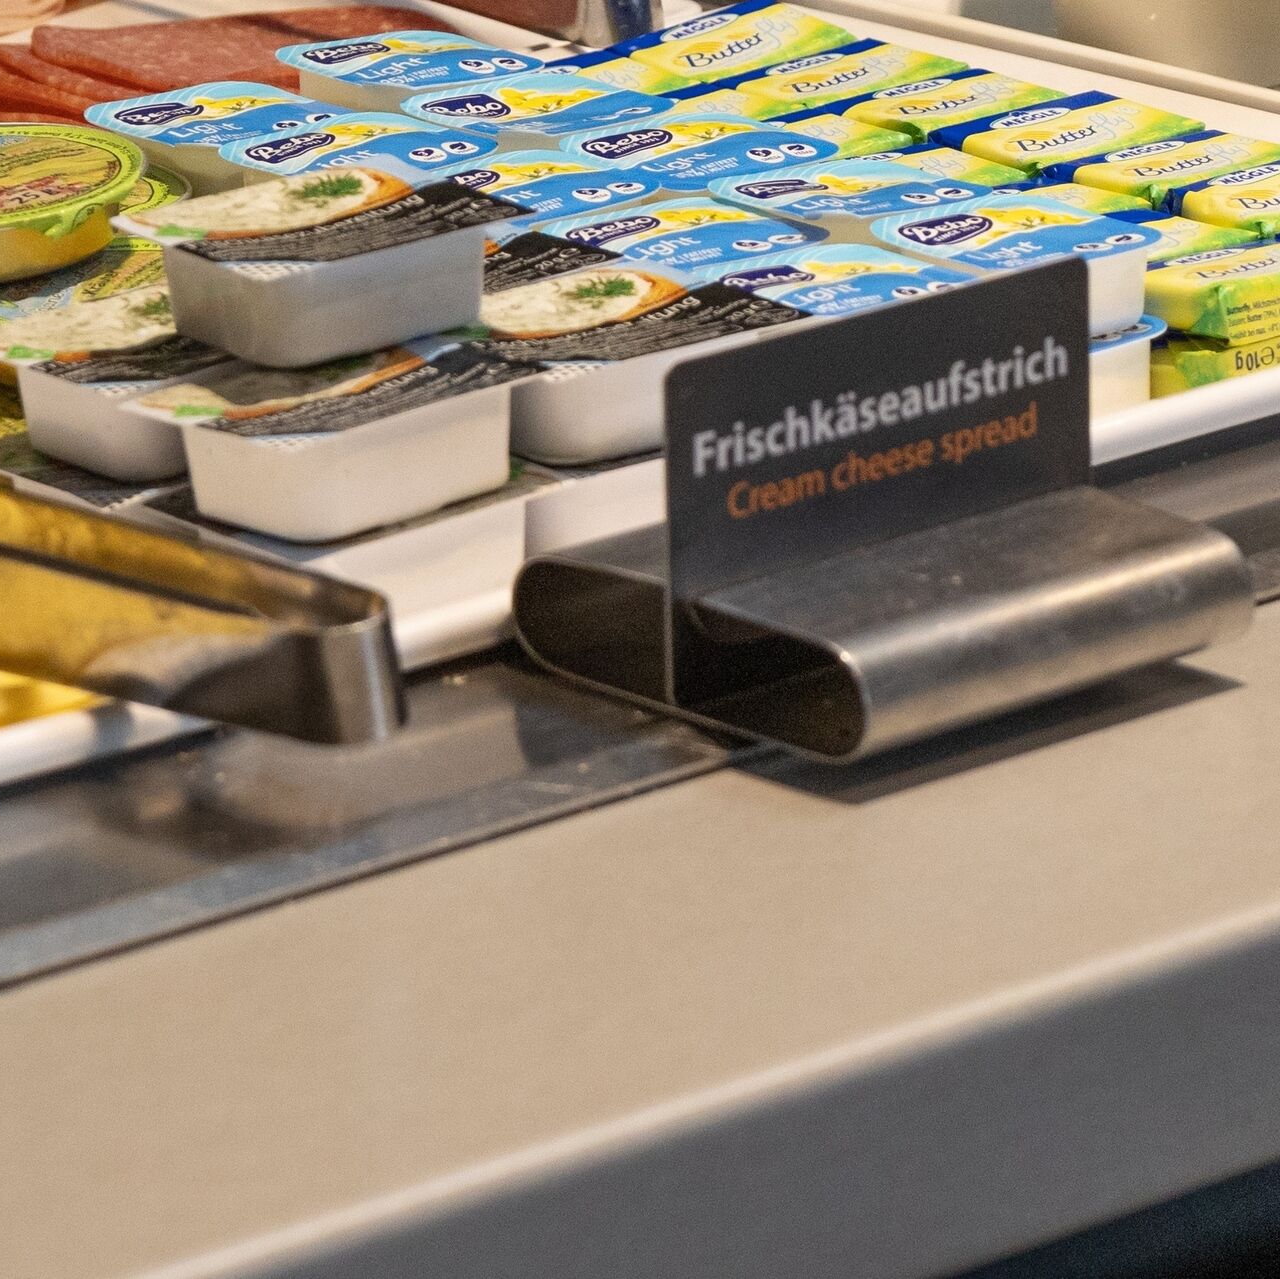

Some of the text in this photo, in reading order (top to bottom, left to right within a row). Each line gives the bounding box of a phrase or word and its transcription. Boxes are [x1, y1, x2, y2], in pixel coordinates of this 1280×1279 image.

[356, 56, 429, 81] Light
[883, 79, 944, 98] MEGGLE
[1003, 109, 1063, 128] MEGGLE
[587, 130, 665, 155] Bebo
[1118, 141, 1177, 160] MEGGLE
[641, 152, 717, 172] Light
[1220, 164, 1279, 186] MEGGLE
[572, 216, 653, 242] Bebo
[910, 214, 984, 242] Bebo
[624, 235, 701, 263] Light
[783, 283, 861, 307] Light
[691, 335, 1069, 478] Frischkäseaufstrich
[725, 400, 1039, 520] Cream cheese spread
